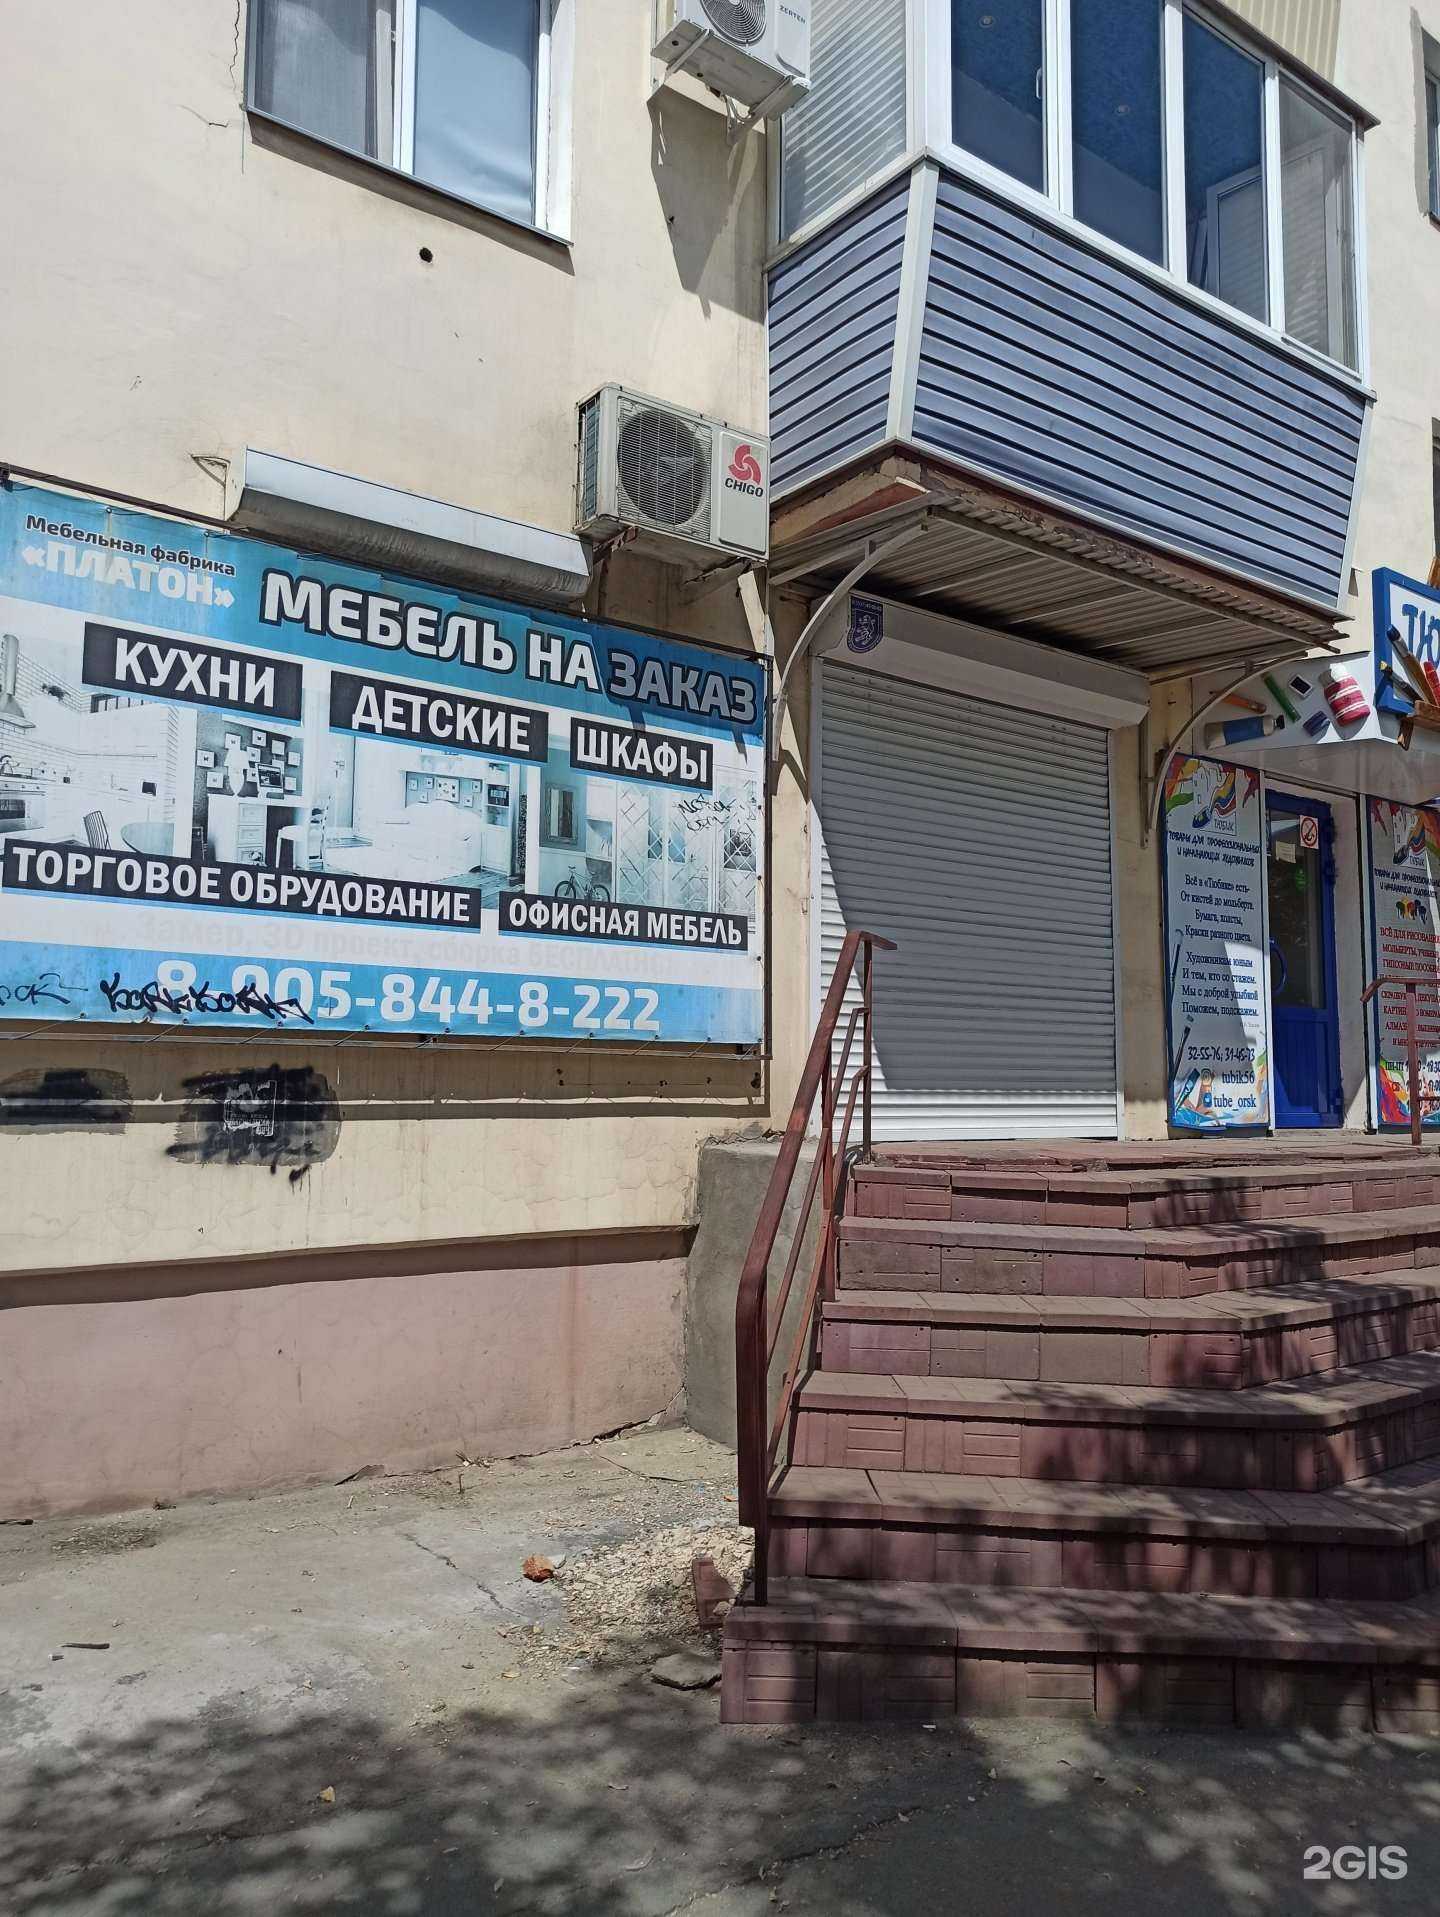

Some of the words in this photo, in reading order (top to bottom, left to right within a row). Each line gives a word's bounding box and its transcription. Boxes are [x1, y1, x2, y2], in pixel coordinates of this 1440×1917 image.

[724, 477, 764, 498] CHIGO
[26, 514, 146, 556] Мебельная
[150, 543, 236, 577] фабрика
[21, 541, 236, 608] «ПЛАТОН»
[261, 569, 517, 673] МЕБЕЛЬ
[526, 630, 601, 690] НА
[608, 651, 756, 723] ЗАКАЗ
[115, 638, 275, 708] КУХНИ
[352, 686, 530, 752] ДЕТСКИЕ
[576, 726, 708, 783] ШКАФЫ
[12, 847, 221, 900] ТОРГОВОЕ
[229, 869, 470, 922] ОБРУДОВАНИЕ
[1181, 890, 1190, 902] От
[1214, 898, 1222, 906] до
[508, 898, 639, 936] ОФИСНАЯ
[647, 916, 742, 945] МЕБЕЛЬ
[1185, 925, 1209, 939] Краски
[1182, 968, 1189, 979] И
[1208, 973, 1220, 981] кто
[1222, 974, 1230, 982] со
[1182, 985, 1196, 996] Мы
[1203, 987, 1229, 1001] доброй
[1182, 1002, 1220, 1016] Поможем,
[1221, 1070, 1255, 1084] tubik56
[1213, 1093, 1257, 1111] tube_orsk
